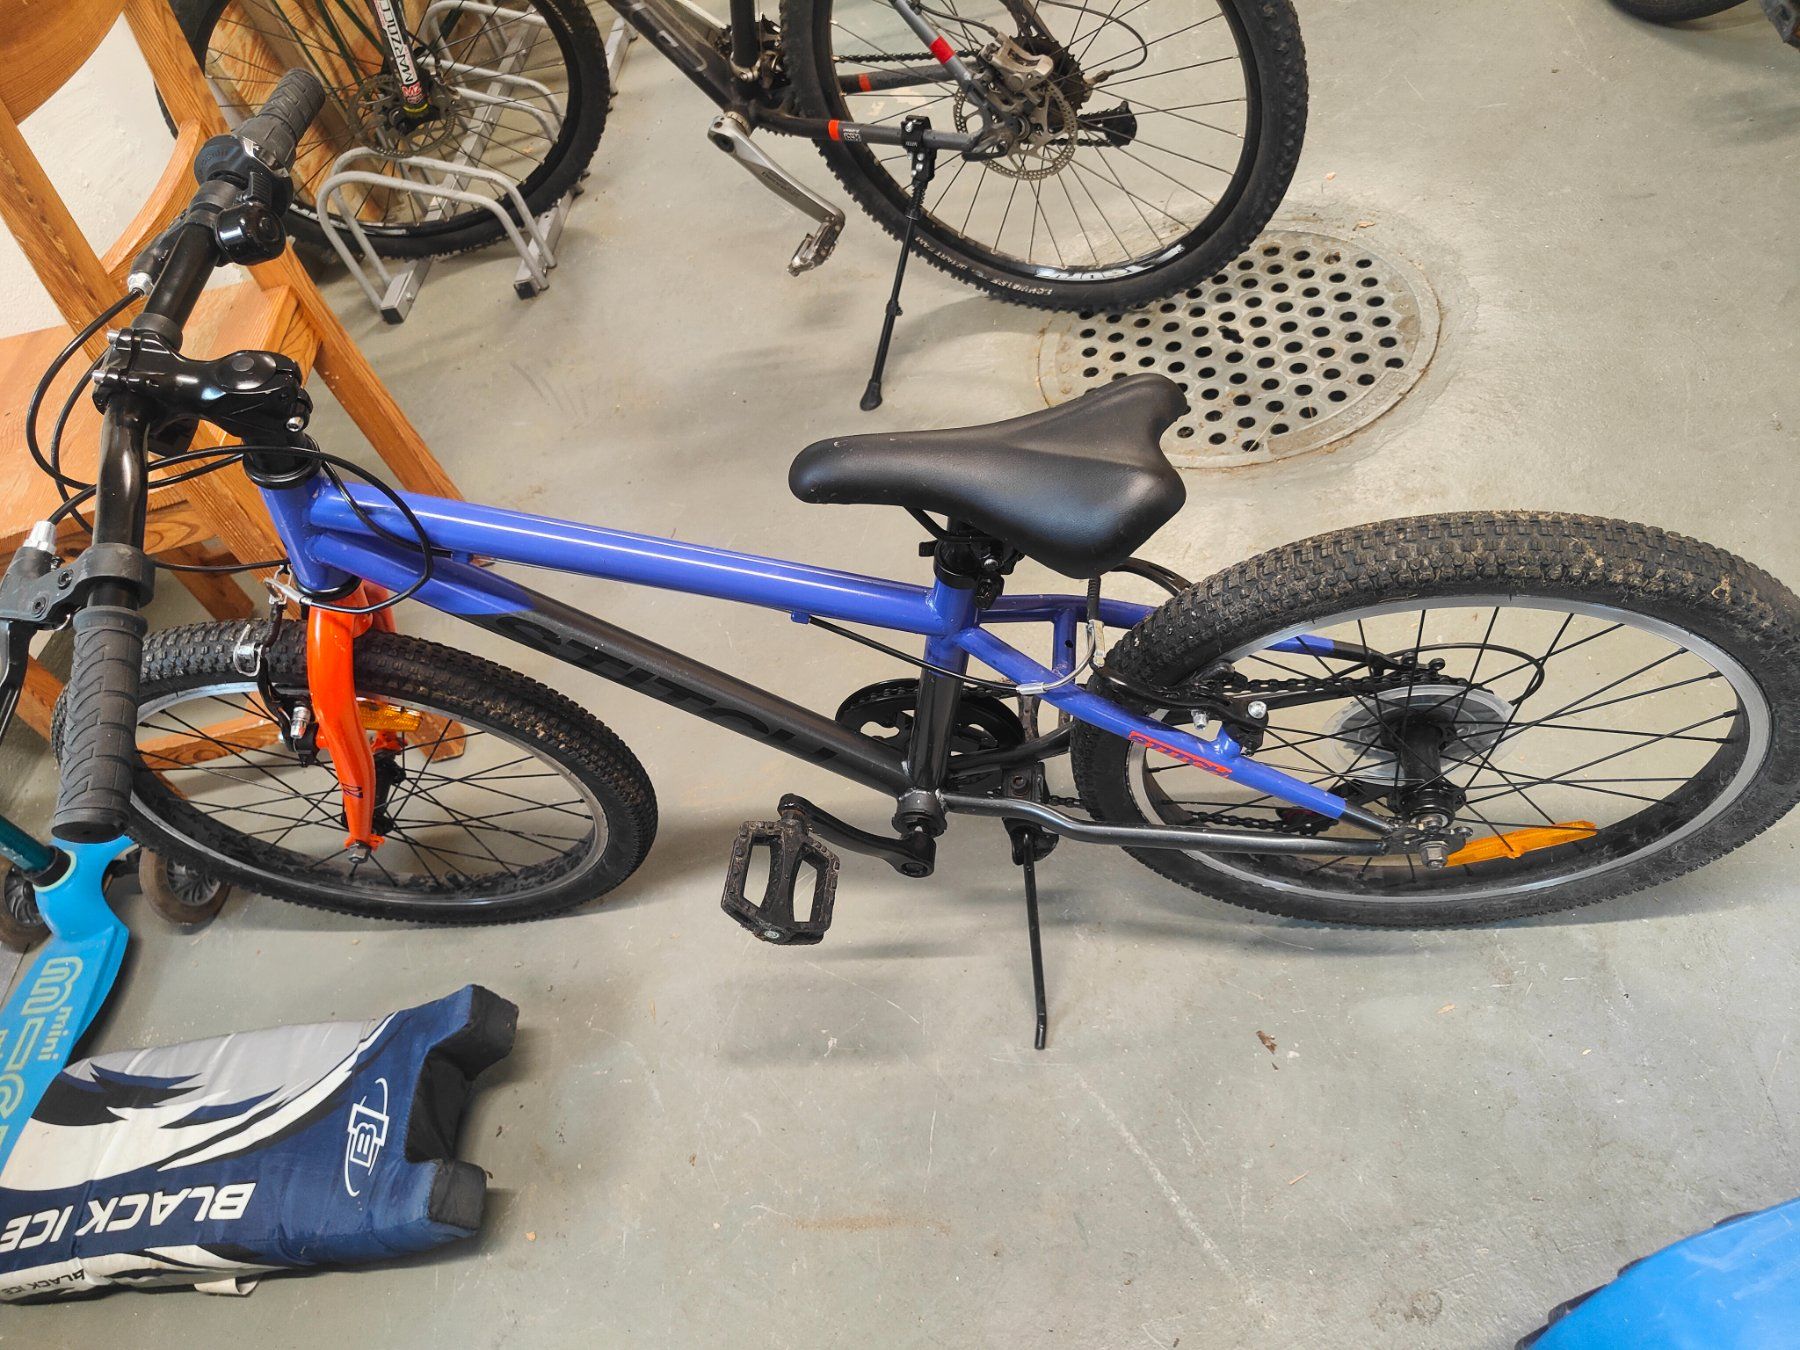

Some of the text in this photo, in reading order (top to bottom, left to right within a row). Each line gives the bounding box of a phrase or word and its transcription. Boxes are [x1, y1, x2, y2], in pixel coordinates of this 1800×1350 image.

[38, 1006, 73, 1060] mini
[0, 1182, 257, 1254] BLACK ICE
[27, 1268, 85, 1290] BLACK
